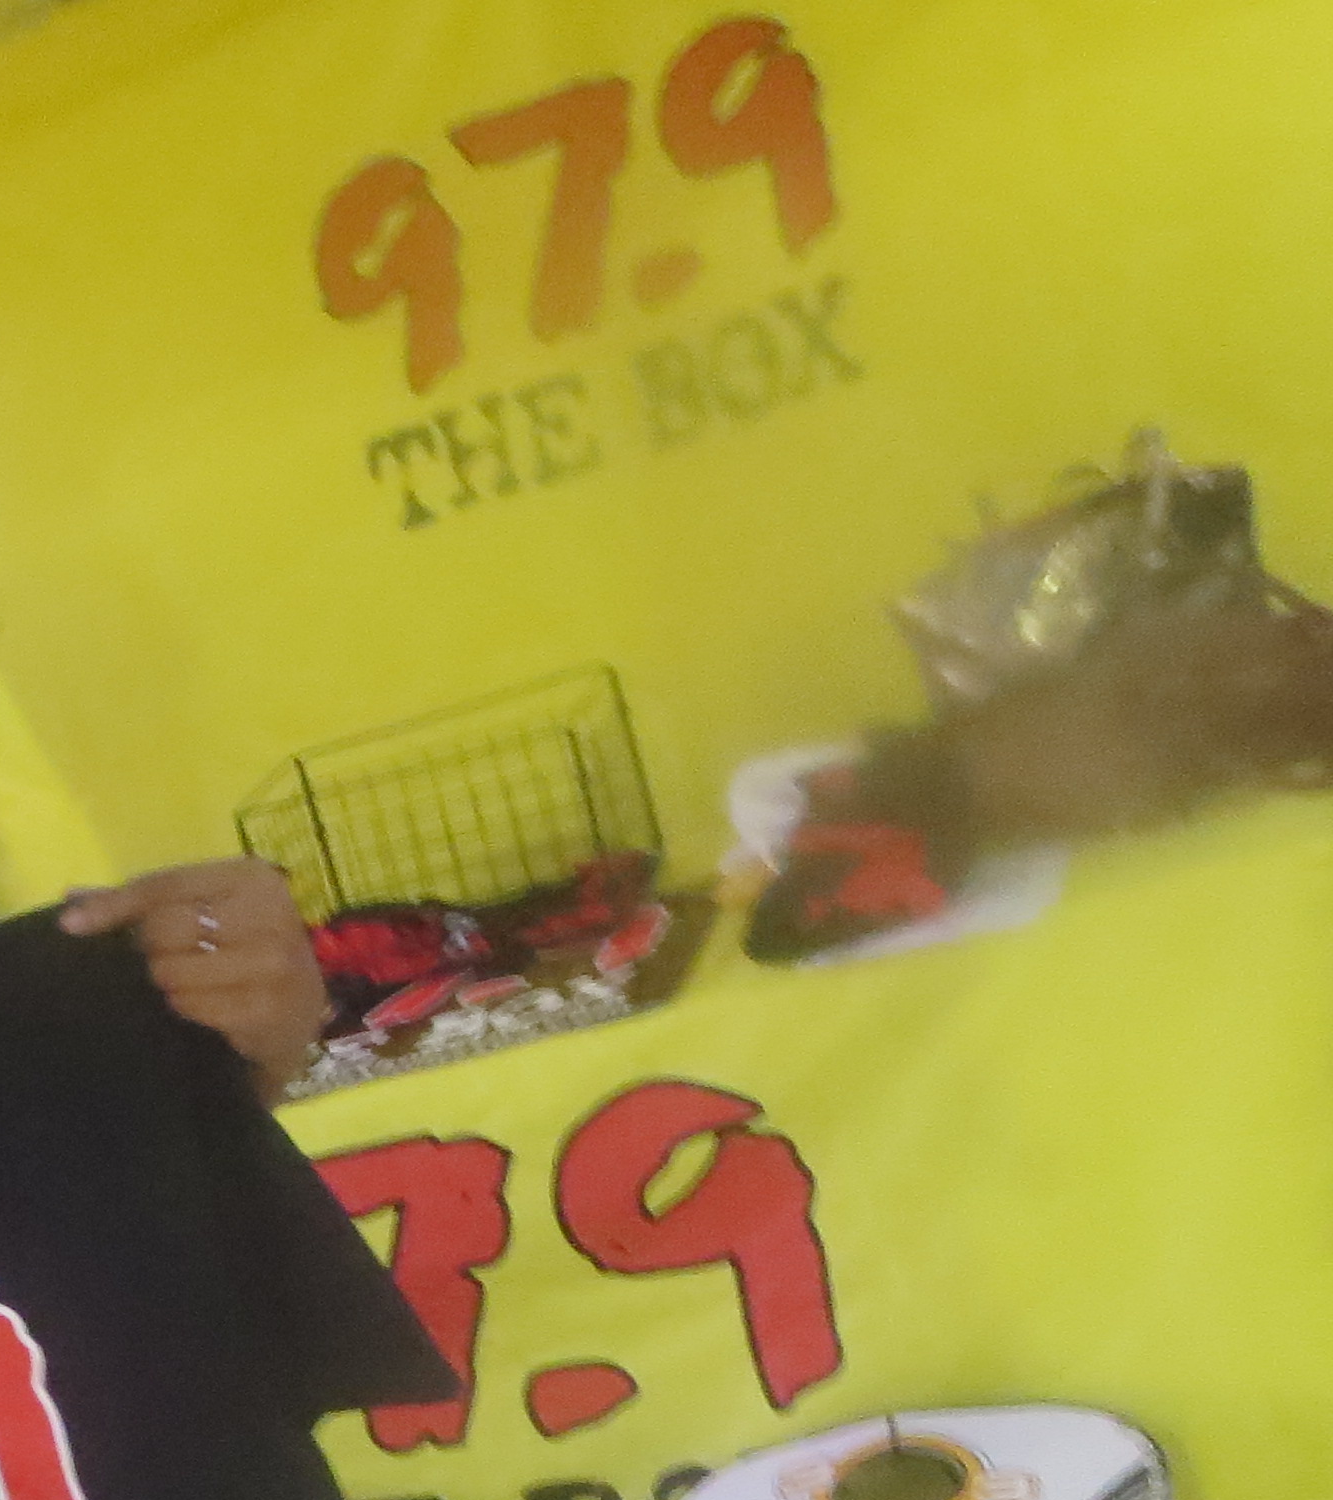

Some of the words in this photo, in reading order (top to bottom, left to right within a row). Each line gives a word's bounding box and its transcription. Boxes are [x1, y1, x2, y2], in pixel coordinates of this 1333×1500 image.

[315, 15, 839, 395] 97.9
[367, 376, 599, 530] THE
[633, 275, 865, 450] BOX
[311, 1080, 843, 1452] 7.9
